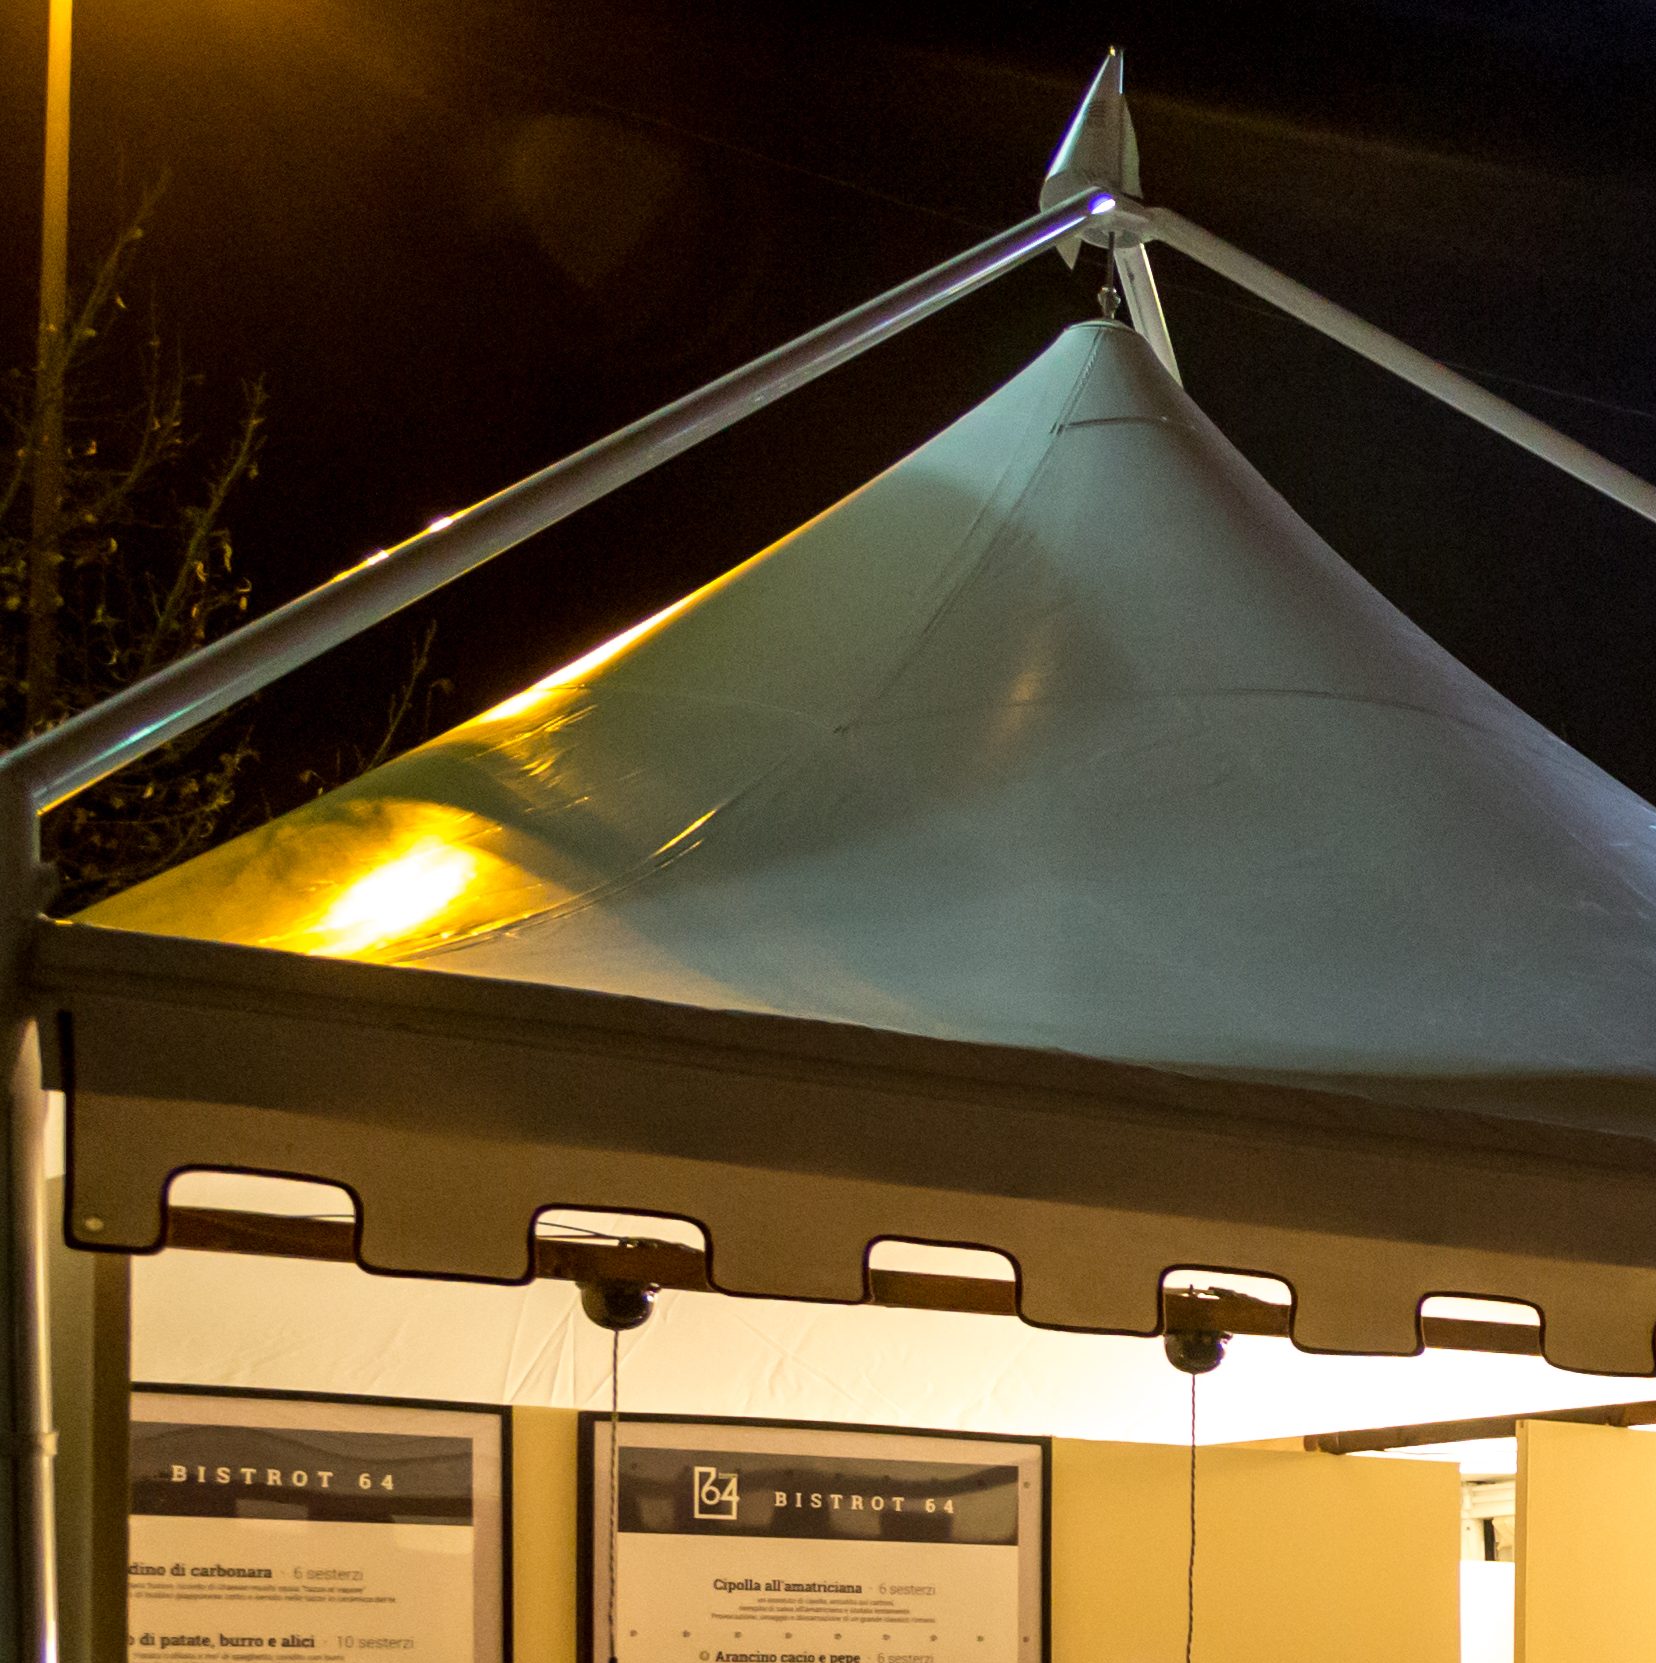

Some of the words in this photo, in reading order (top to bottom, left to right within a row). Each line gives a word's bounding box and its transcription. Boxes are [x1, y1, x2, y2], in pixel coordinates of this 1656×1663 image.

[171, 1463, 335, 1490] BISTROT
[358, 1472, 396, 1491] 64
[774, 1491, 905, 1514] BISTROT
[925, 1497, 956, 1516] 64
[170, 1563, 186, 1577] di
[191, 1564, 272, 1579] carbonara
[713, 1578, 761, 1595] Cipolla
[878, 1583, 888, 1596] 6
[139, 1632, 156, 1646] di
[219, 1633, 263, 1647] burro
[267, 1637, 277, 1648] e
[281, 1634, 315, 1648] alici
